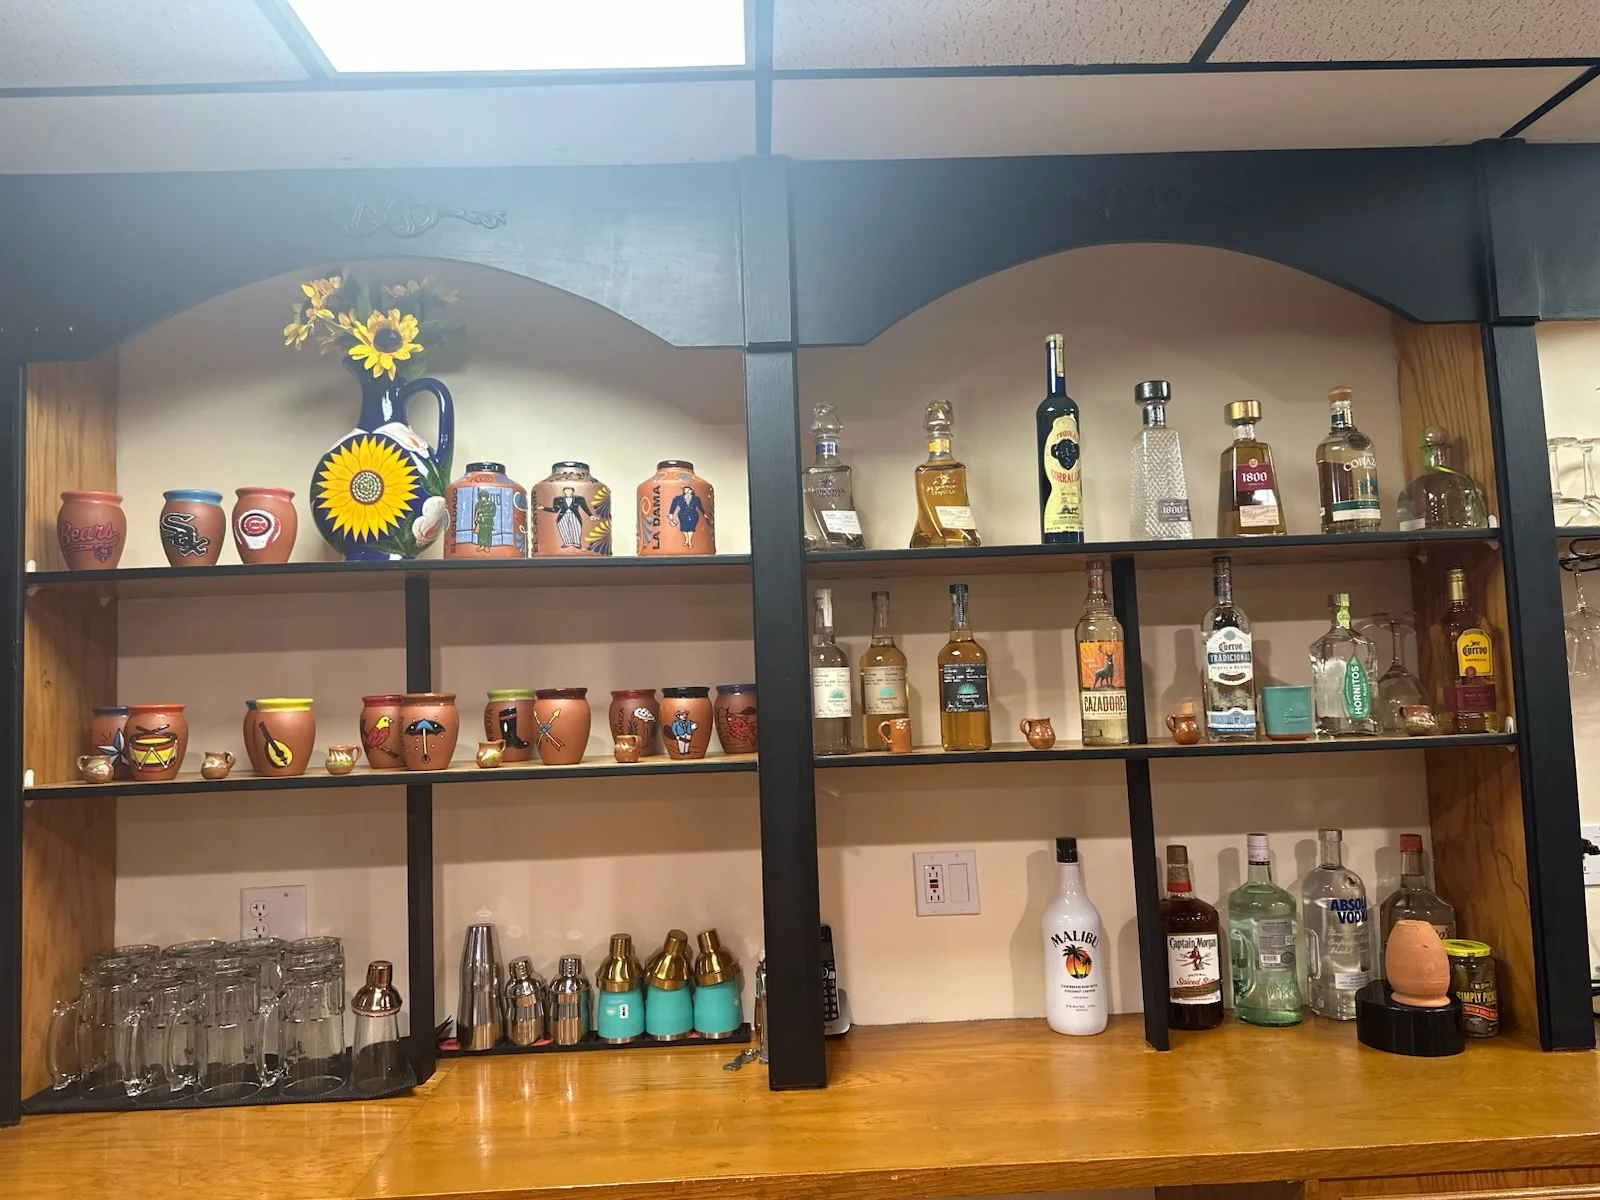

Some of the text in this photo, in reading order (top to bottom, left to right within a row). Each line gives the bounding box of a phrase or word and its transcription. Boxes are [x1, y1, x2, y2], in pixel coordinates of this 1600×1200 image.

[1241, 471, 1268, 482] 1800
[1162, 504, 1183, 514] 1800
[652, 485, 661, 550] LA DAMA
[60, 521, 113, 547] Bears
[1218, 641, 1243, 652] Cuervo
[1462, 644, 1488, 657] Cuervo
[1209, 652, 1251, 663] TRADICIONAL
[1351, 665, 1363, 715] HORNITOS
[1051, 930, 1100, 948] MALIBU
[1169, 937, 1196, 950] Captain
[1456, 990, 1482, 1003] SIMPLY
